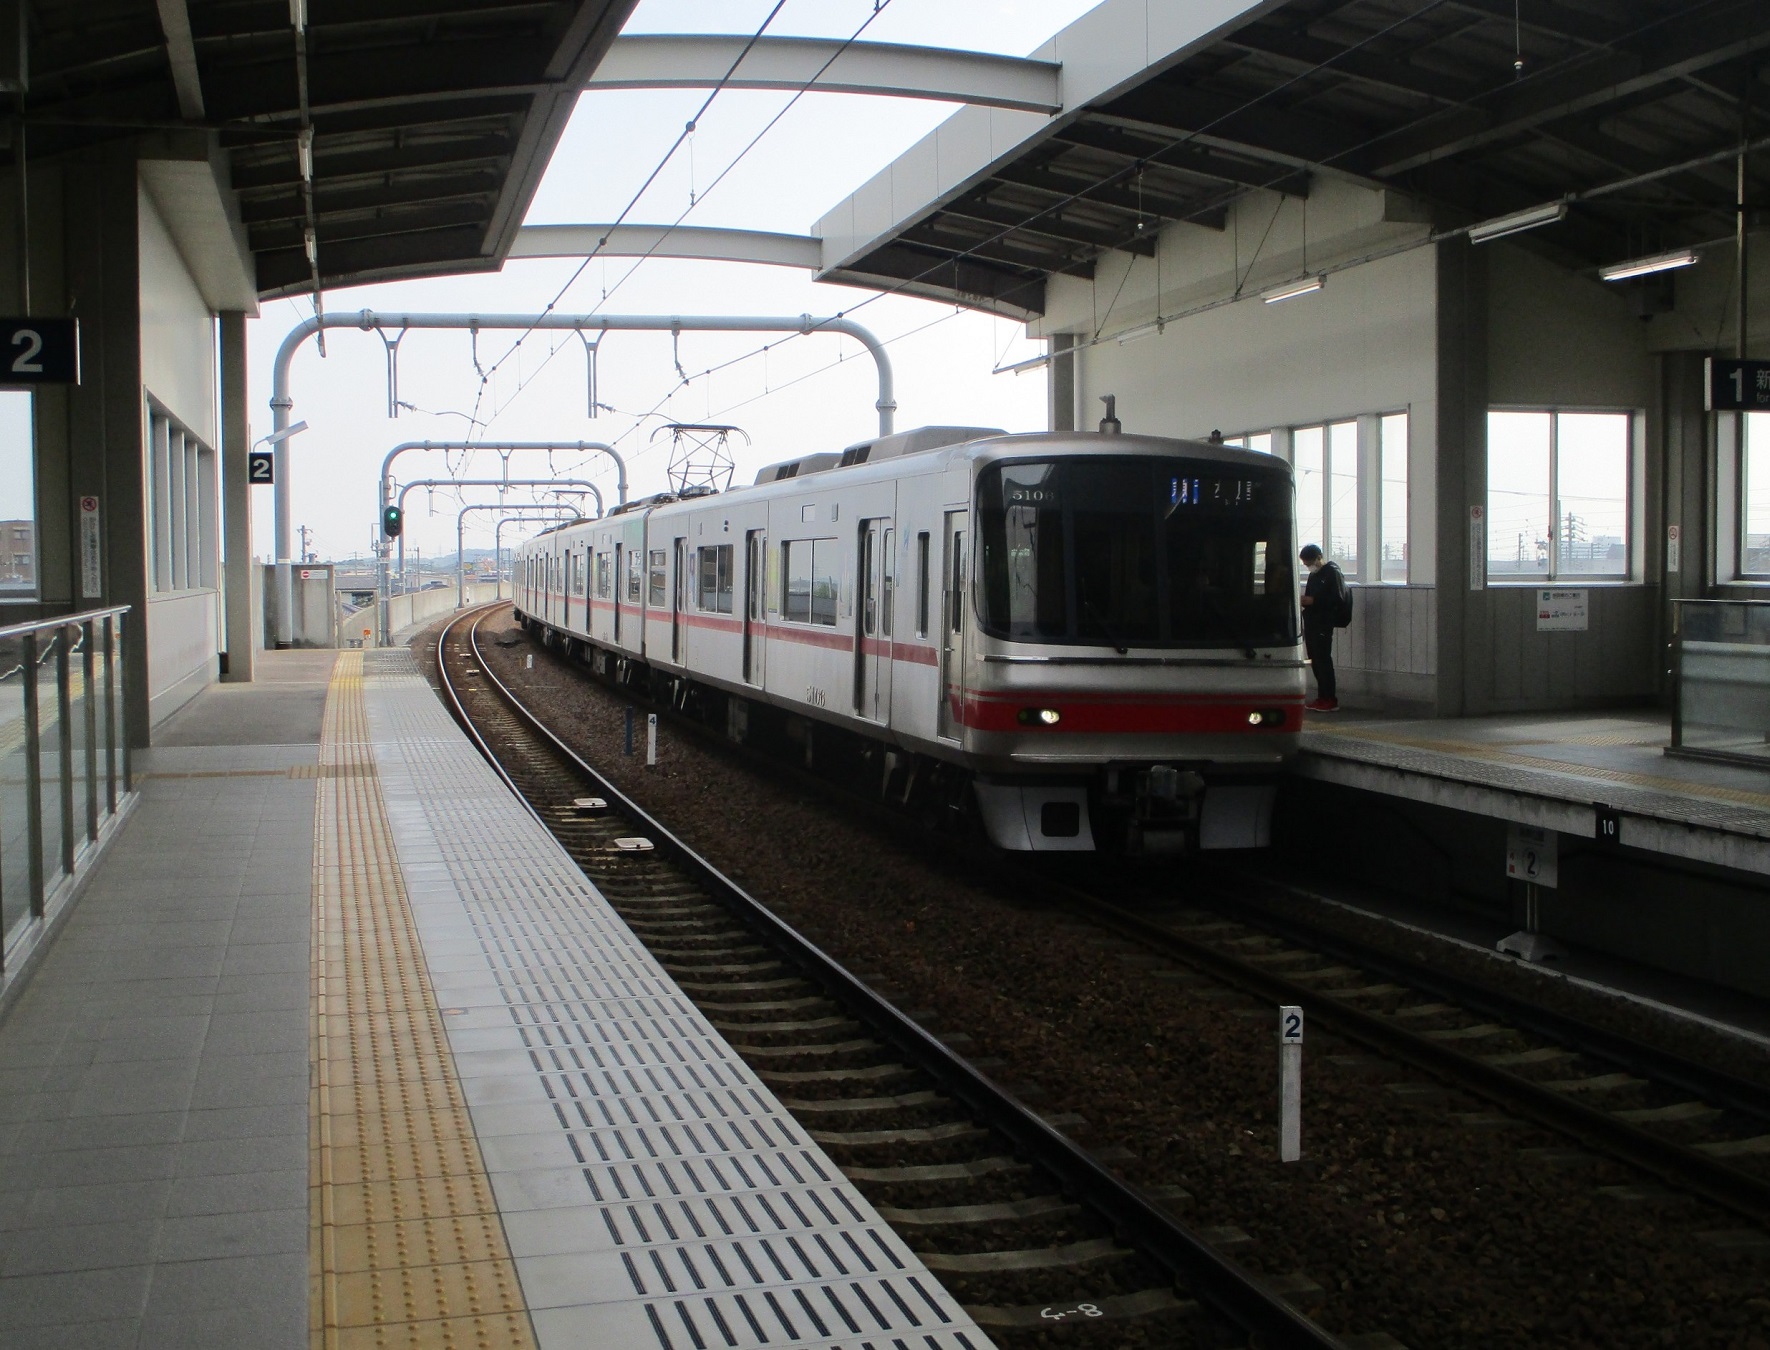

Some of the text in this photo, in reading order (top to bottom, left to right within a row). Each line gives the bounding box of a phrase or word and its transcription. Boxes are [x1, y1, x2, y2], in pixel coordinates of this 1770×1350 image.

[11, 330, 43, 372] 2
[1730, 368, 1742, 402] 1
[1756, 369, 1770, 390] 新
[254, 459, 270, 478] 2
[649, 717, 656, 725] 4
[1602, 819, 1614, 835] 10
[1527, 851, 1536, 875] 2
[1285, 1014, 1301, 1038] 2
